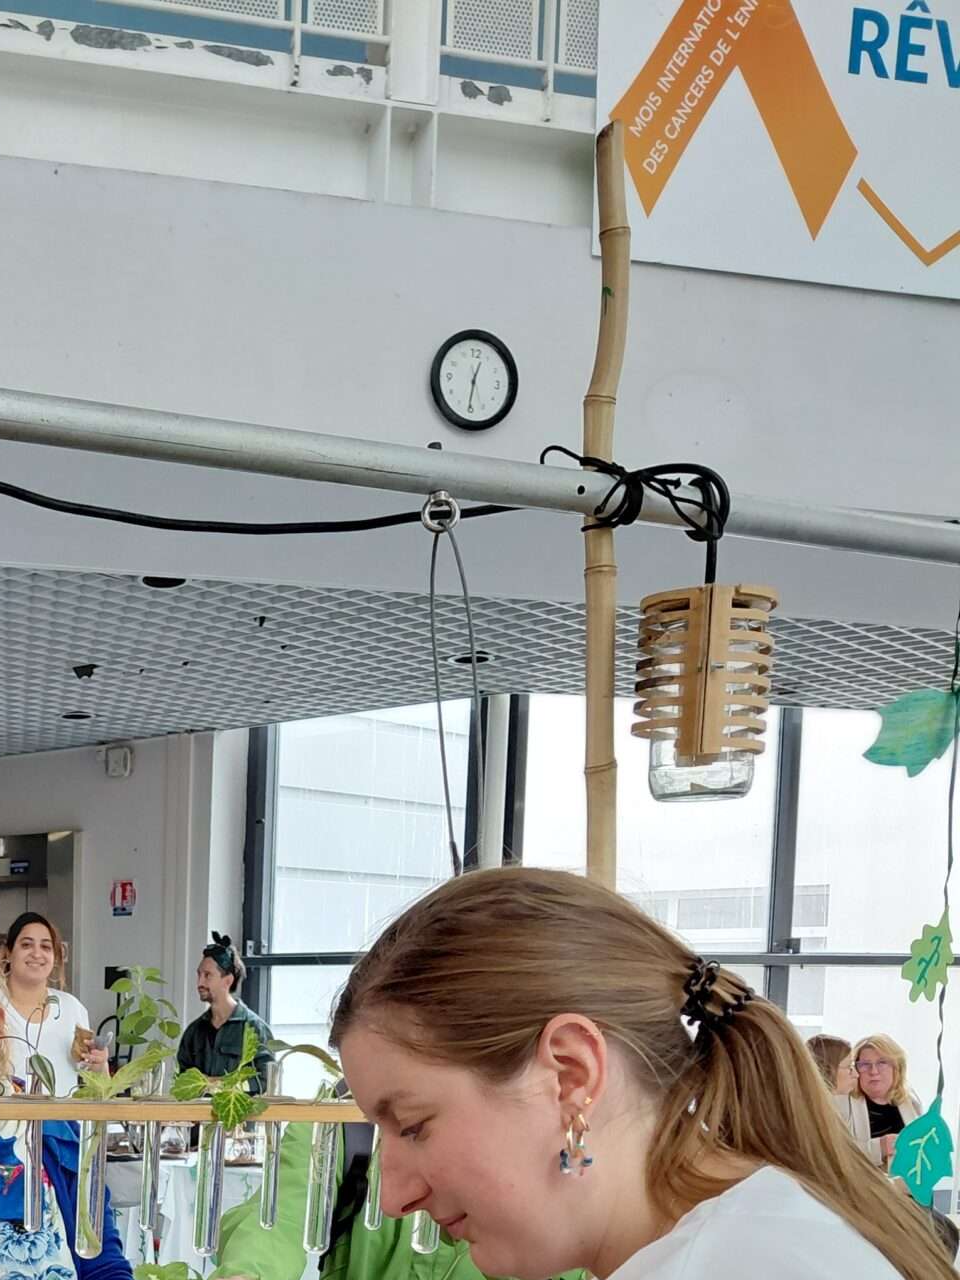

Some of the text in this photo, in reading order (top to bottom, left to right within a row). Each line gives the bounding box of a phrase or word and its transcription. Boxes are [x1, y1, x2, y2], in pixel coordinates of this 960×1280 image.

[642, 0, 760, 175] DES CANCERS DE L'EN
[628, 91, 662, 138] MOIS
[470, 347, 482, 359] 12
